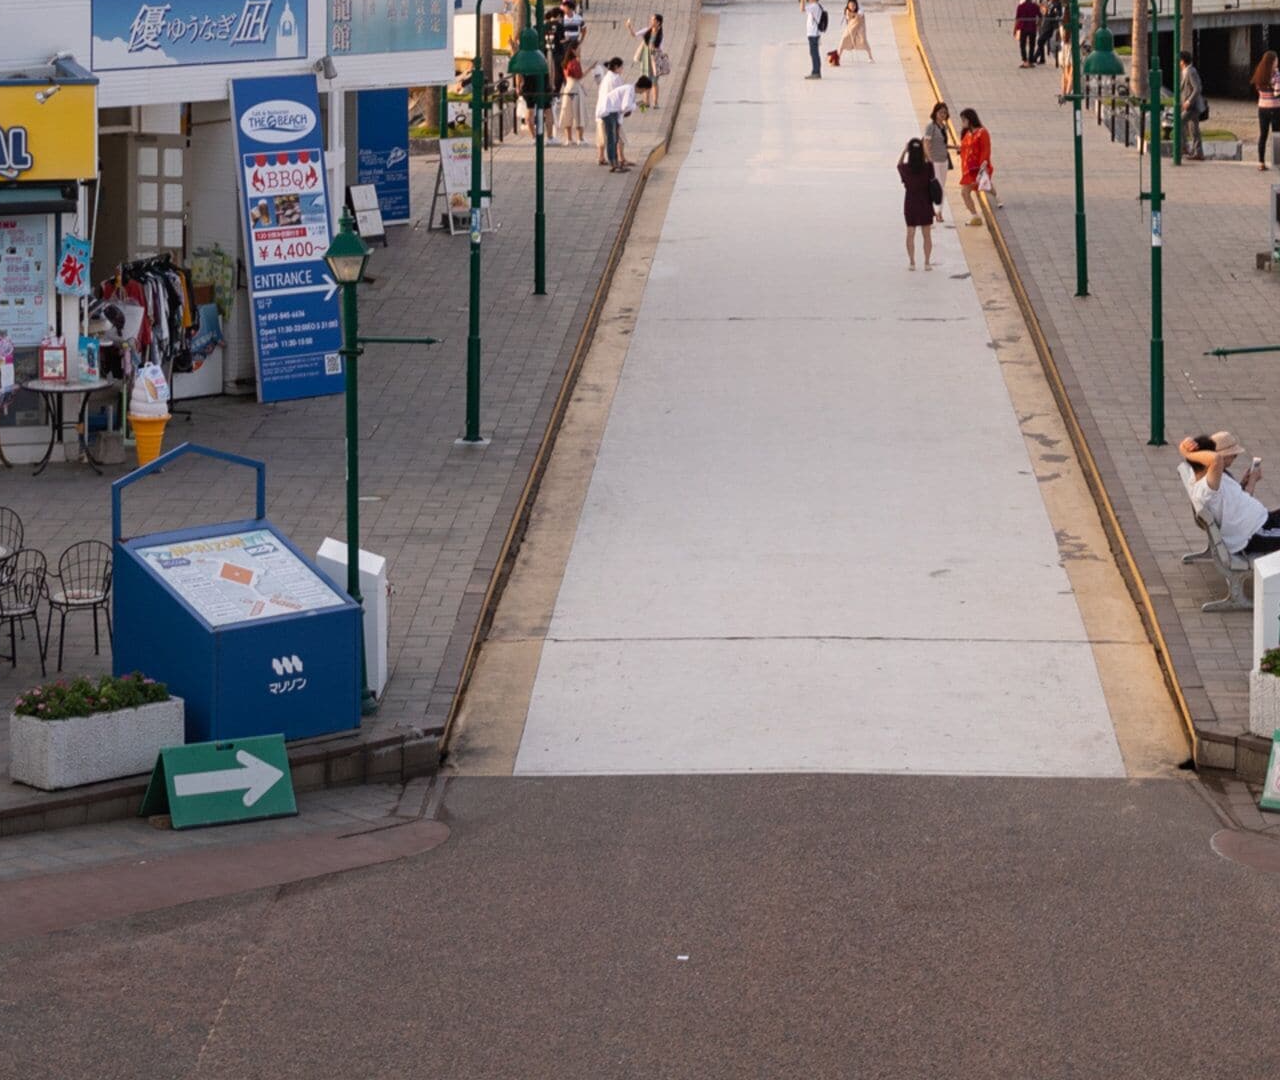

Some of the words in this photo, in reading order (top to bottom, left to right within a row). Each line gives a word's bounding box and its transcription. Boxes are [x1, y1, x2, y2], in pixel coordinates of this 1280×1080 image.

[248, 116, 266, 128] THE
[278, 114, 308, 126] BEACH
[266, 170, 305, 190] BBQ
[259, 245, 269, 261] ¥
[61, 254, 84, 287] 氷
[254, 269, 312, 289] ENTRANCE
